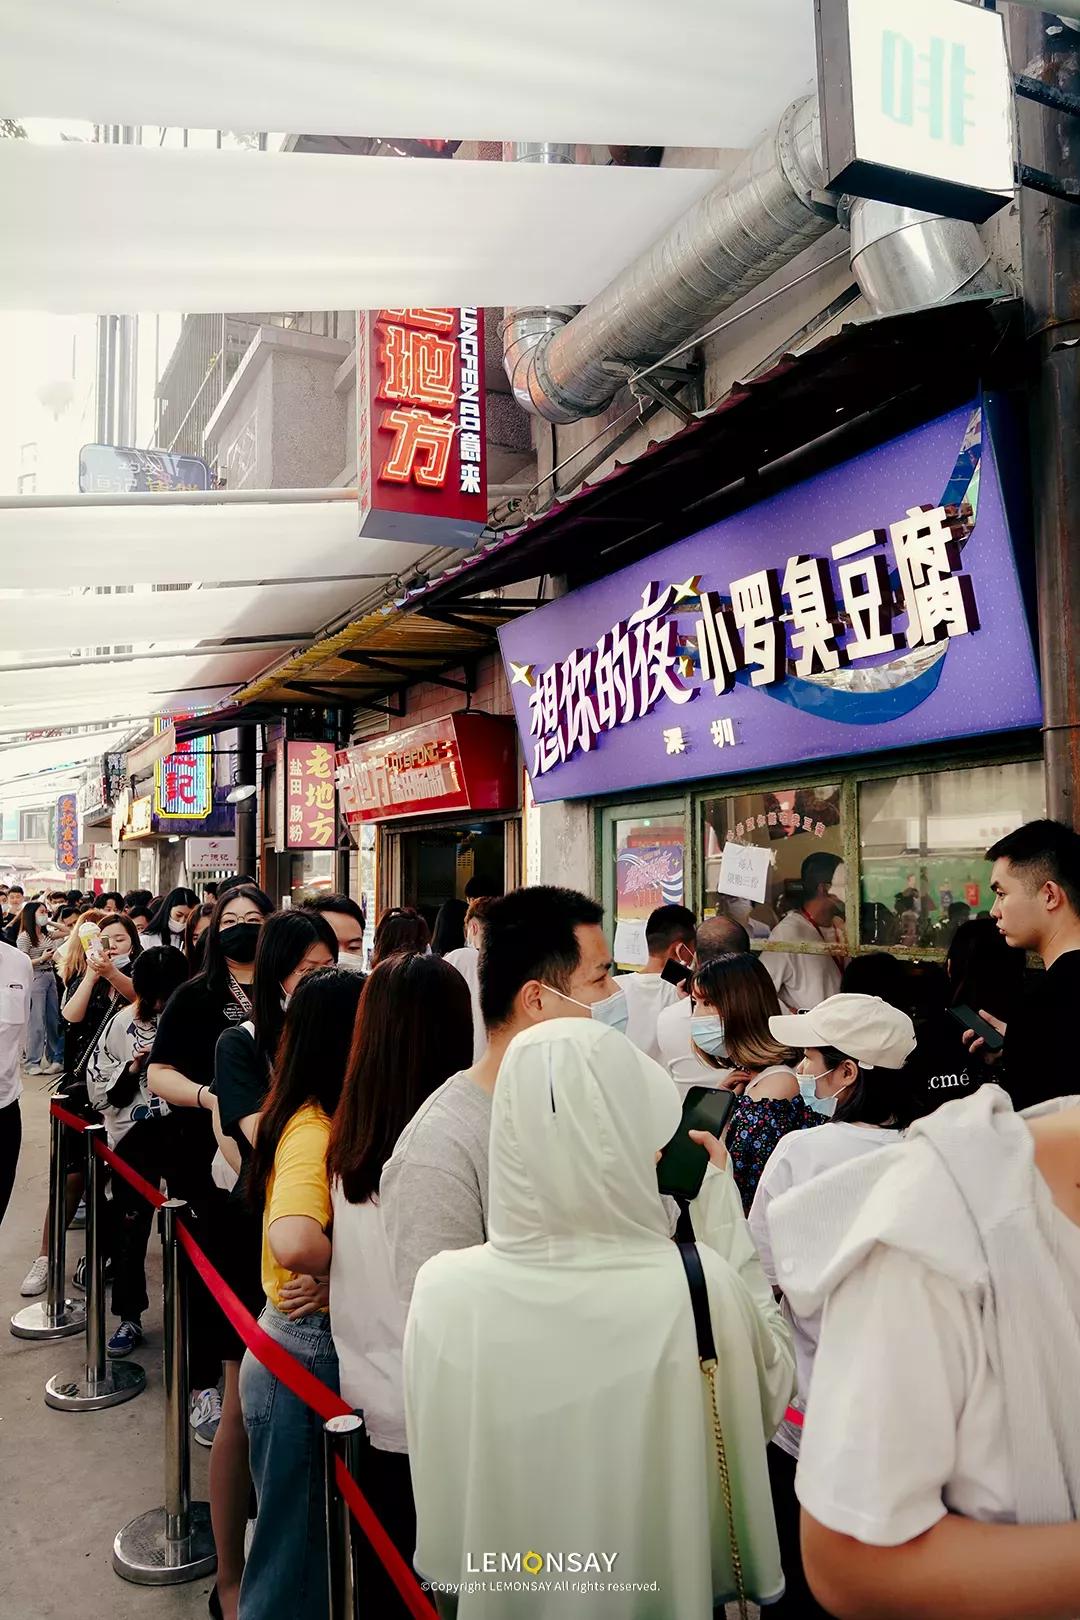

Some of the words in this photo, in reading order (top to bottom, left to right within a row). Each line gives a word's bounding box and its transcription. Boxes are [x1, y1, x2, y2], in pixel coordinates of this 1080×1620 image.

[457, 307, 480, 402] UNGFEN
[529, 580, 695, 778] 想你的夜
[695, 504, 975, 697] 小罗臭豆腐
[662, 718, 735, 755] 深圳
[305, 744, 335, 847] 老地方
[927, 1067, 970, 1090] cmé
